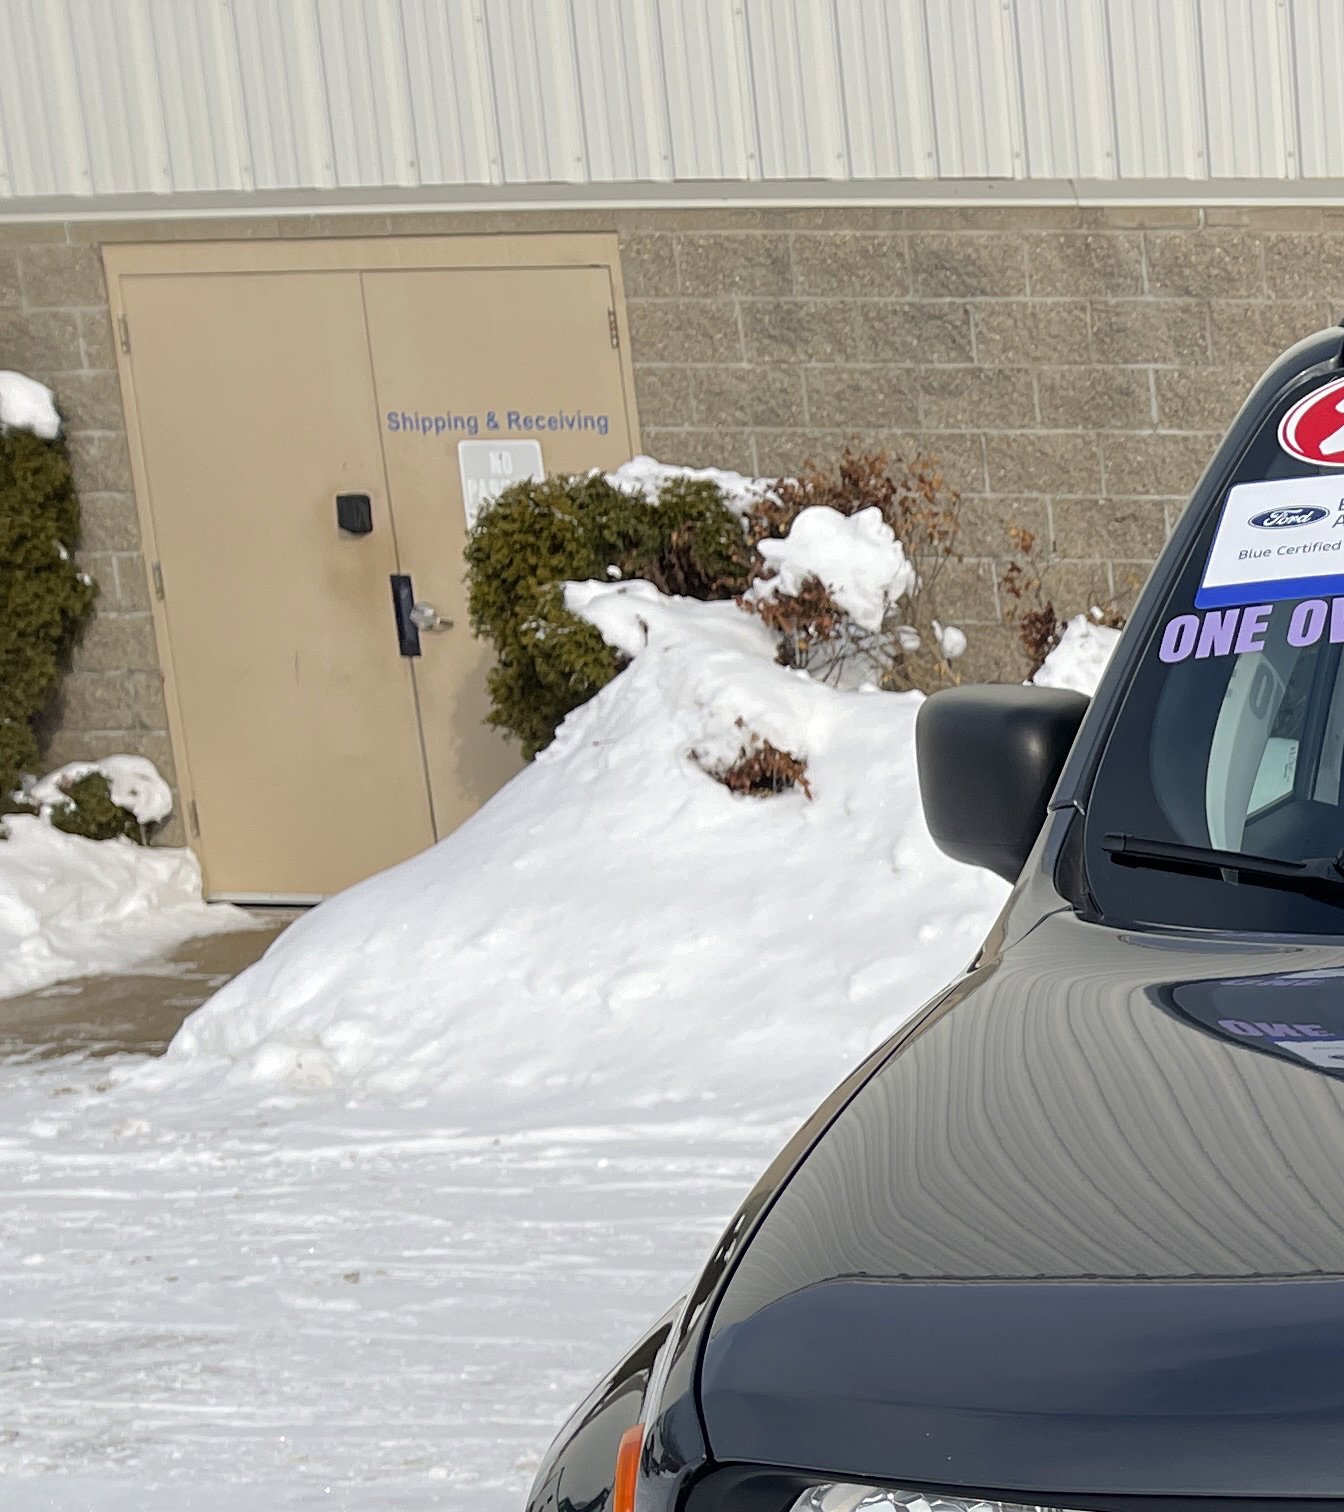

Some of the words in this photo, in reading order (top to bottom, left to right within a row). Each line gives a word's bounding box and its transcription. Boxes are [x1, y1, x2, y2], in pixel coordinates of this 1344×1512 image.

[386, 410, 479, 435] Shipping
[486, 411, 500, 431] &
[507, 410, 610, 436] Receiving
[1238, 548, 1272, 560] Blue
[1277, 539, 1341, 556] Certified
[1158, 602, 1274, 664] ONE
